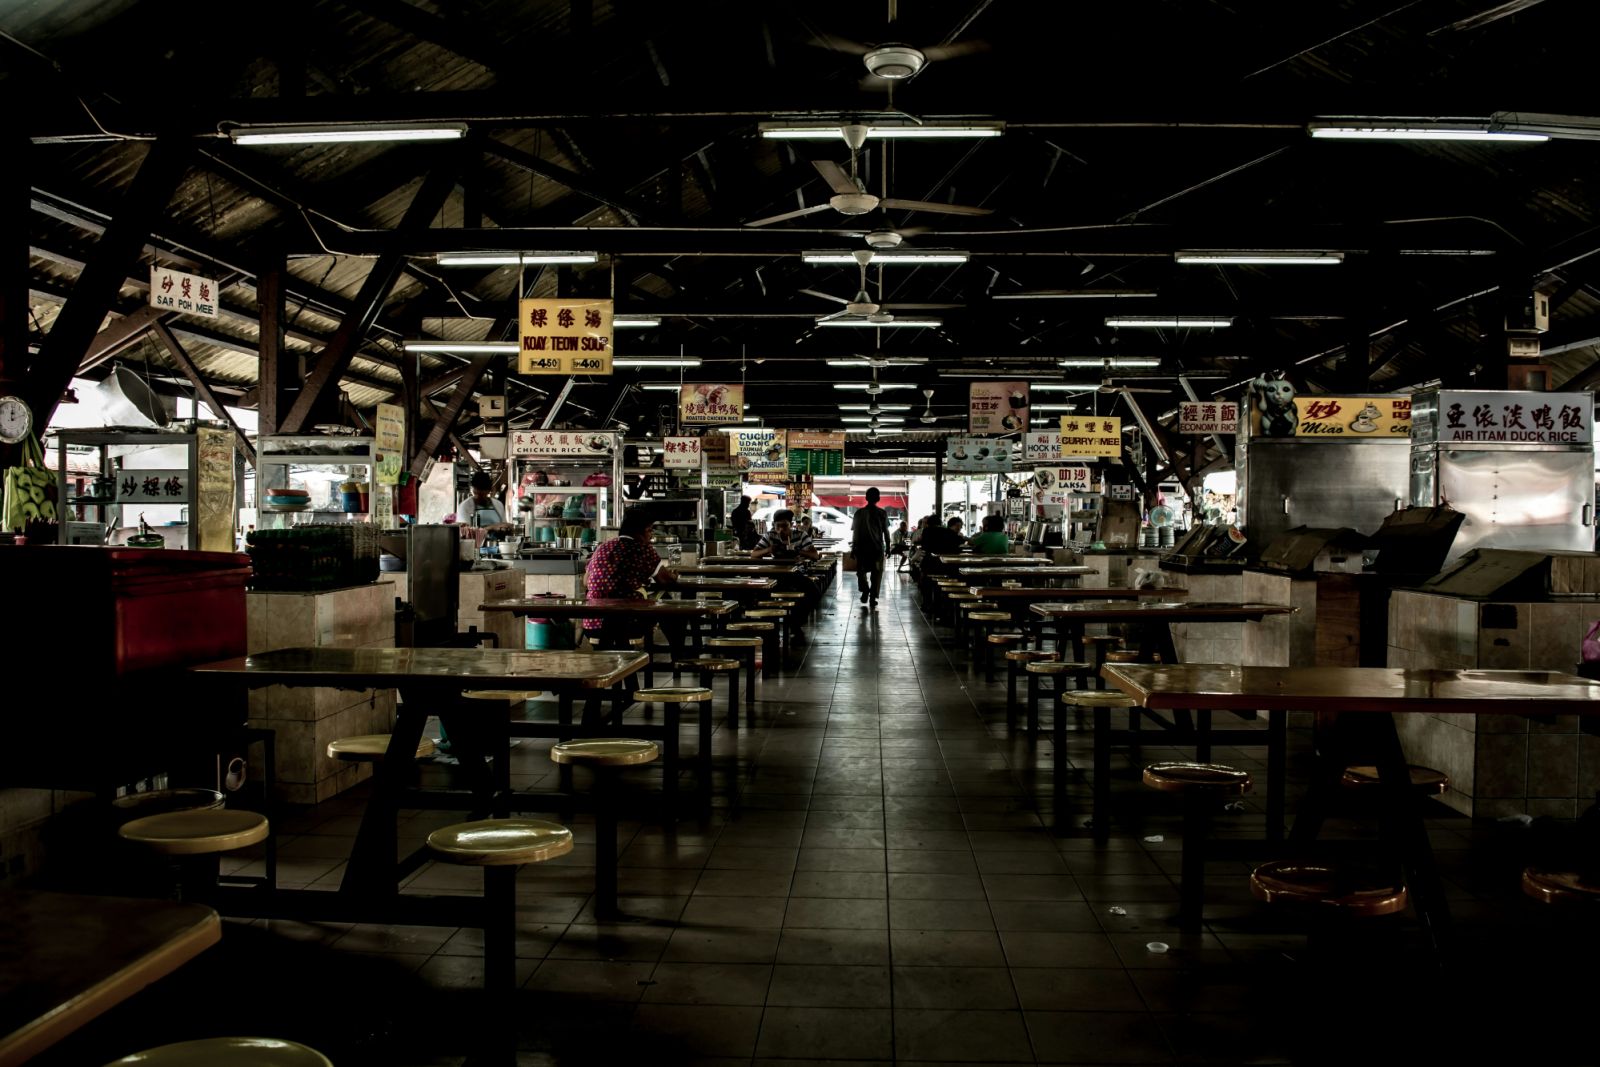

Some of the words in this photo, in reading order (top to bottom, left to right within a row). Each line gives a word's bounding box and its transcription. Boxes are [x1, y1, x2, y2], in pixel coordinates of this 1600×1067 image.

[157, 295, 174, 307] SAR
[178, 299, 192, 310] POH
[196, 303, 214, 315] MEE
[531, 308, 602, 328] 粿條湯
[523, 336, 547, 351] KOAY
[550, 336, 579, 351] TEOW
[581, 337, 608, 351] SOUP
[1183, 405, 1236, 422] 經濟飯
[1303, 400, 1342, 420] 妙
[1180, 423, 1219, 431] ECONOMY
[1301, 422, 1343, 434] Miao
[1061, 437, 1093, 445] CURRY
[1100, 437, 1120, 445] MEE
[1453, 430, 1474, 441] AIR
[1477, 430, 1506, 441] ITAM
[1510, 431, 1545, 441] DUCK
[1548, 431, 1577, 442] RICE
[1027, 444, 1050, 452] HOCK
[1058, 468, 1086, 481] 叻沙
[120, 476, 184, 496] 炒粿條
